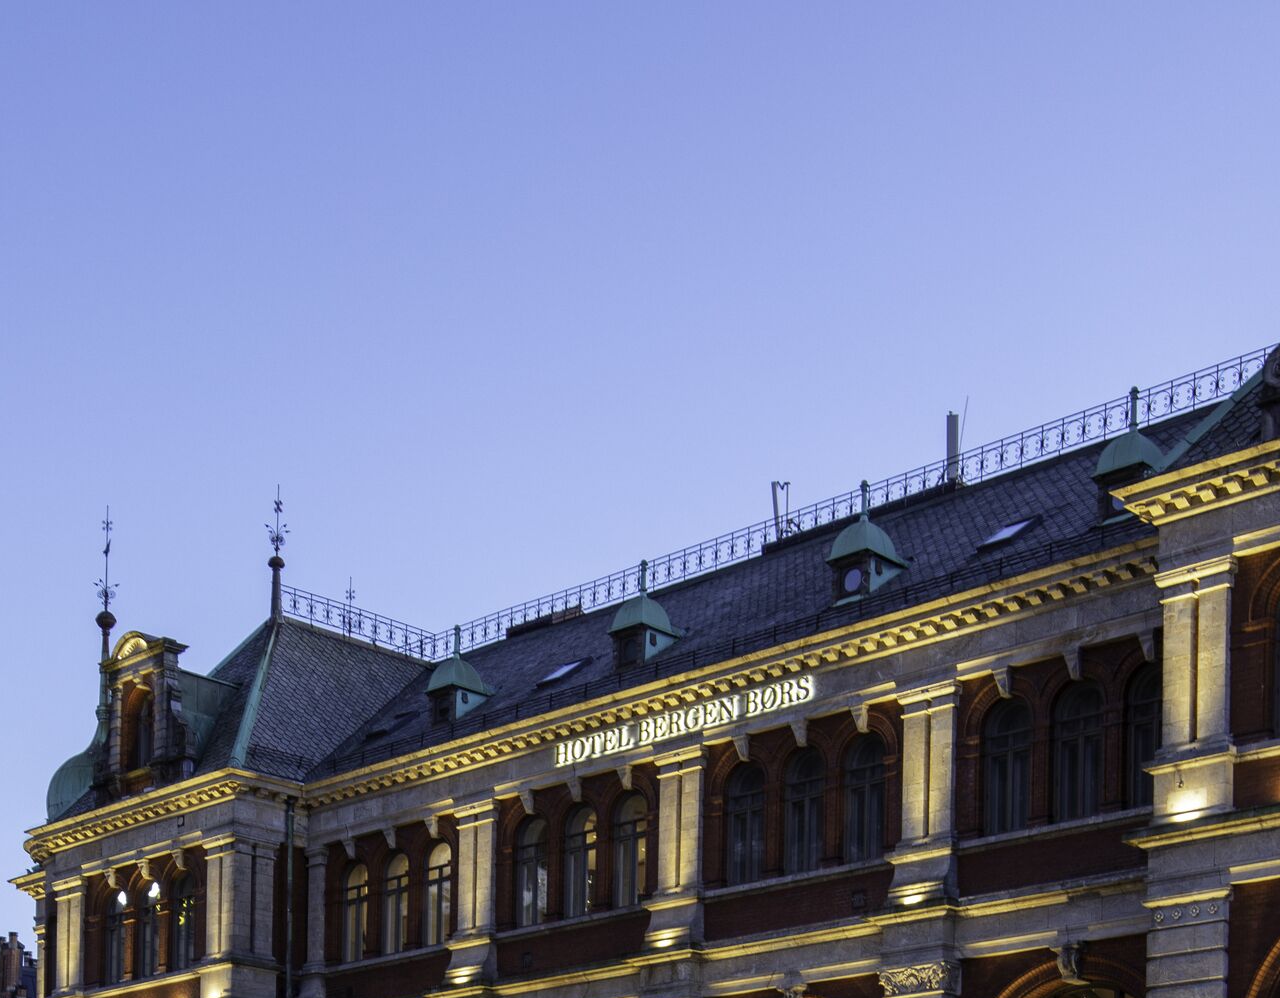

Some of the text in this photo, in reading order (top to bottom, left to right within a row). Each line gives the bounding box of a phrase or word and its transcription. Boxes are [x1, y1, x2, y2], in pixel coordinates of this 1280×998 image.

[554, 675, 814, 767] HOTEL BERGEN BØRS
